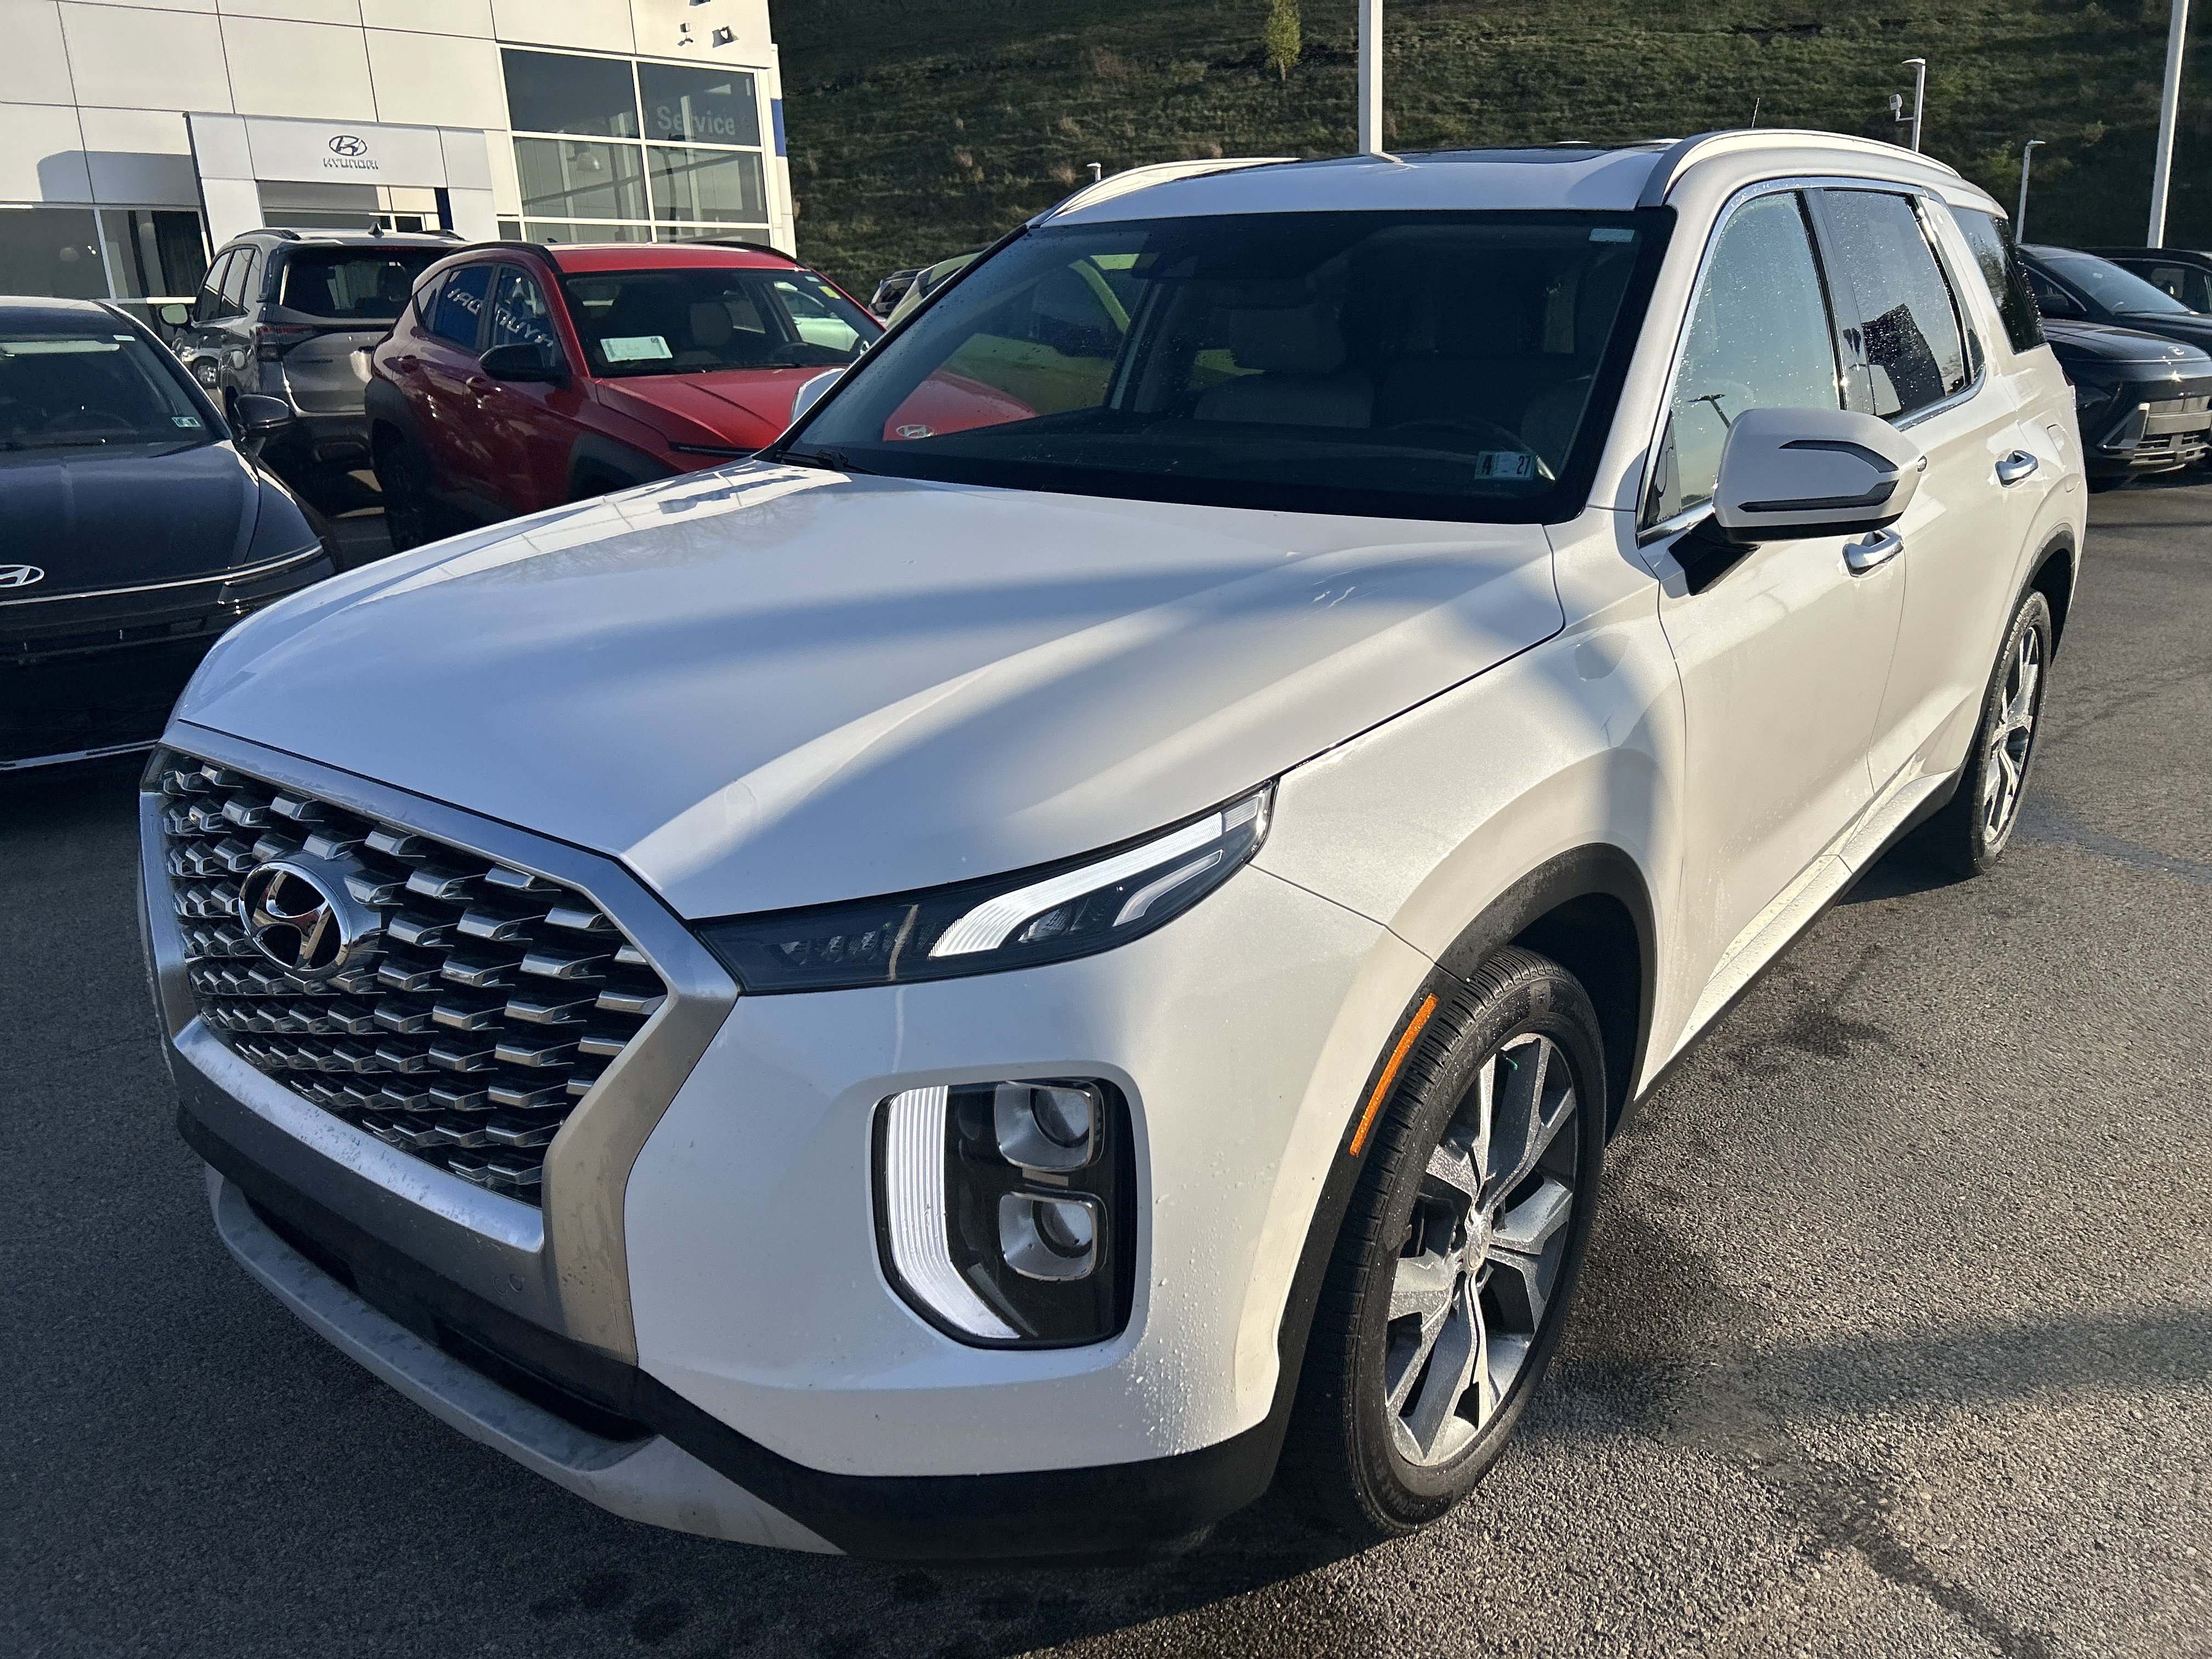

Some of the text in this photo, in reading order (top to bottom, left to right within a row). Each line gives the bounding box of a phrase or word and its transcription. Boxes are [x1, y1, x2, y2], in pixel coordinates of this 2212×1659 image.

[323, 157, 379, 170] HYUNDAI
[1482, 455, 1493, 475] 4
[1516, 455, 1532, 475] 27
